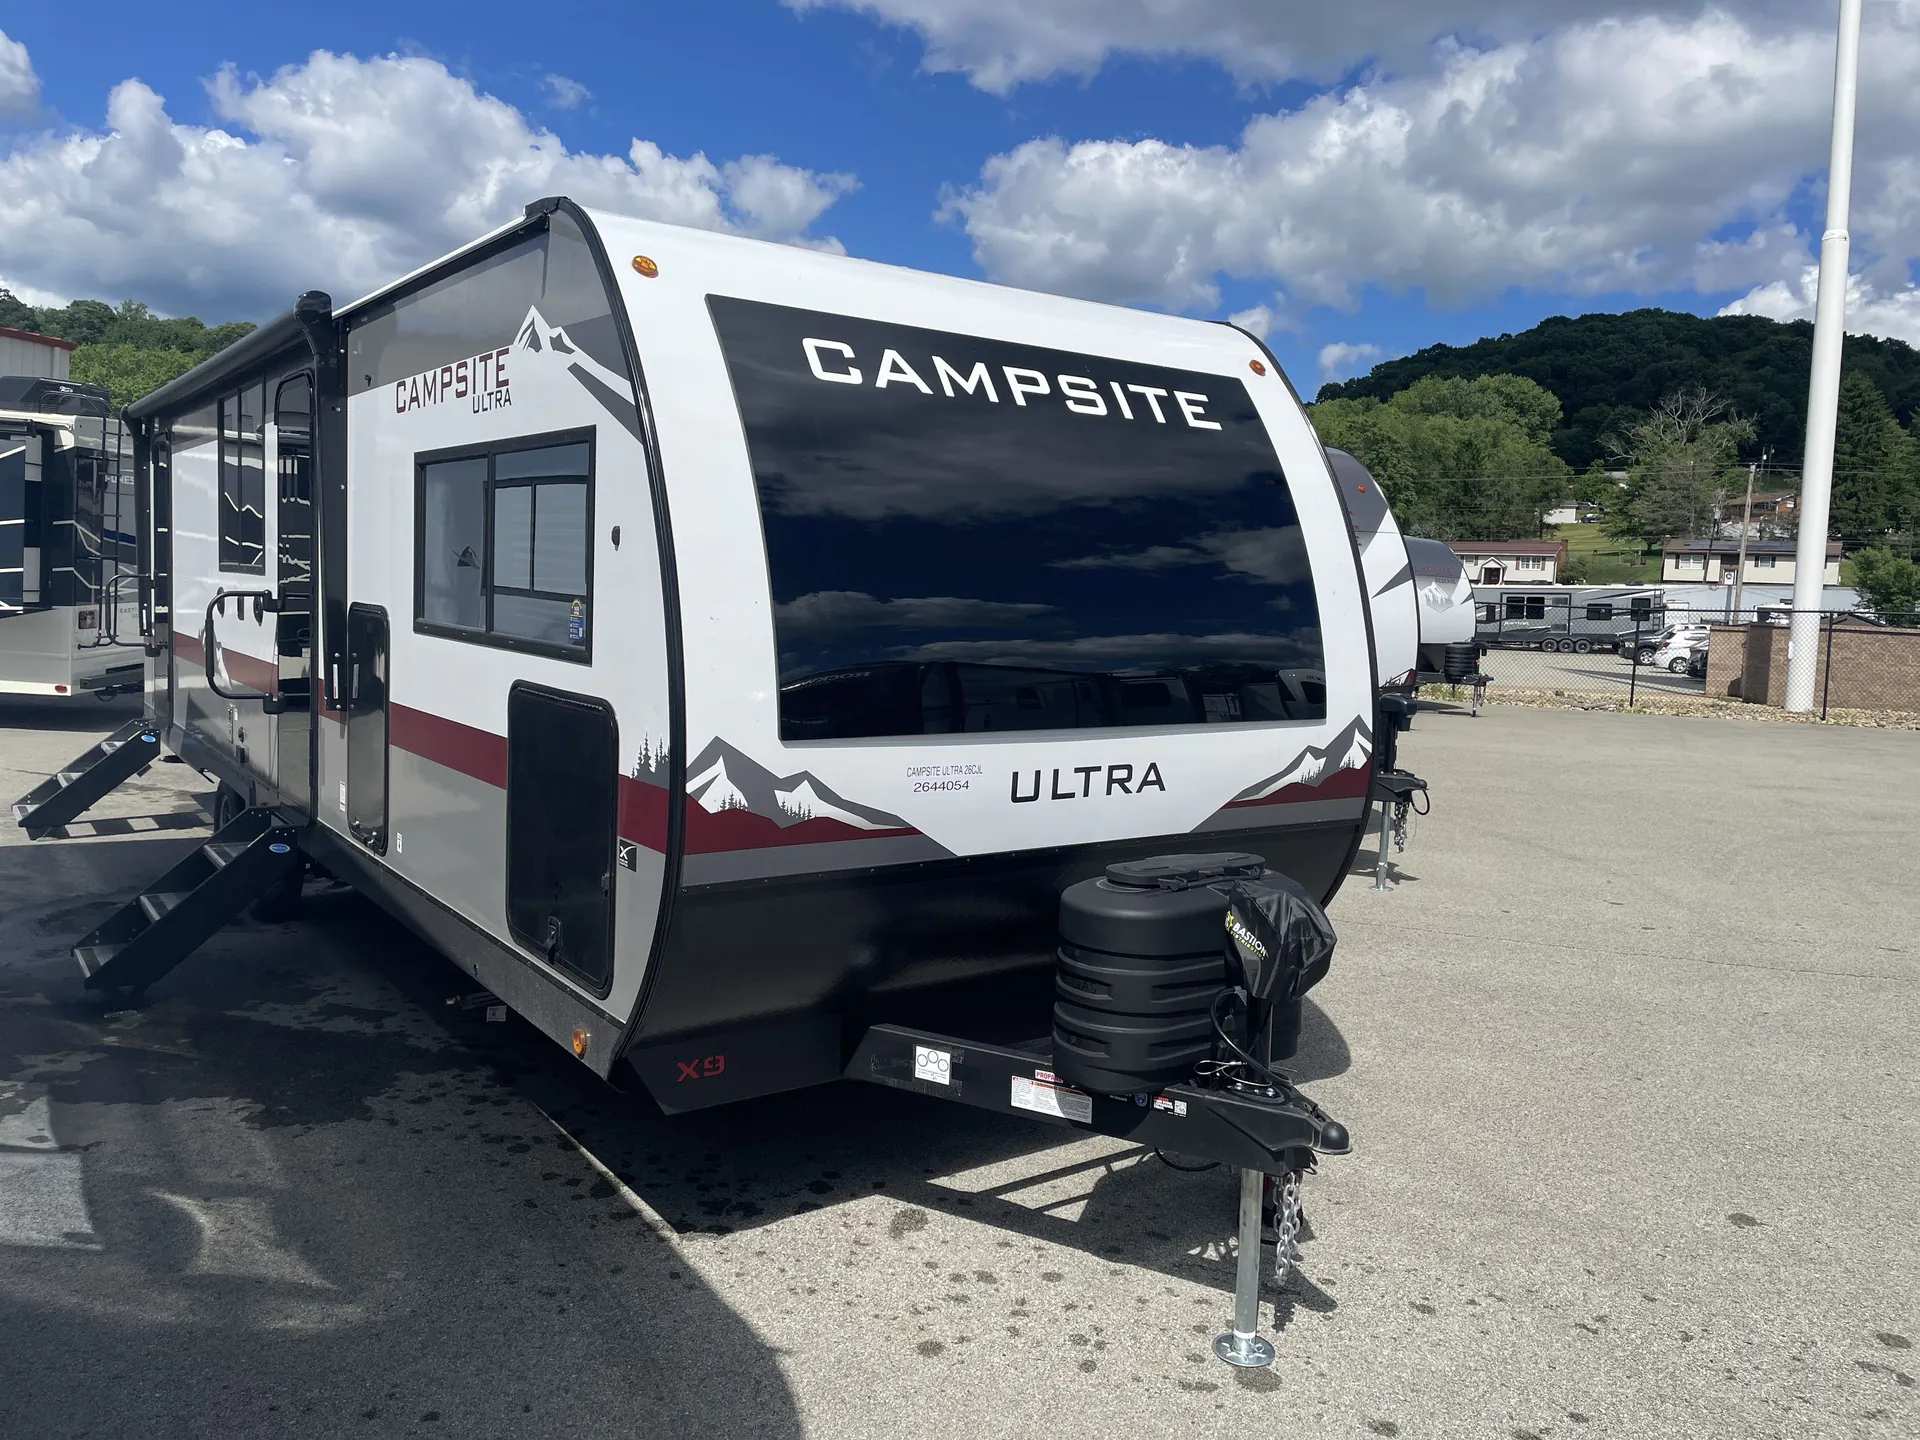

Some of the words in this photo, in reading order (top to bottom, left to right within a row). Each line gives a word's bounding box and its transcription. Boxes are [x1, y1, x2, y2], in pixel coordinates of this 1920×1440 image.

[396, 347, 510, 414] CAMPSITE
[802, 337, 1222, 431] CAMPSITE
[472, 387, 512, 414] ULTRA
[906, 766, 941, 778] CAMPSITE
[942, 765, 963, 776] ULTRA
[964, 764, 983, 775] 26CJL
[913, 780, 970, 793] 2644054
[1010, 762, 1166, 803] ULTRA
[1232, 922, 1269, 959] BASTION
[676, 1055, 725, 1083] X9
